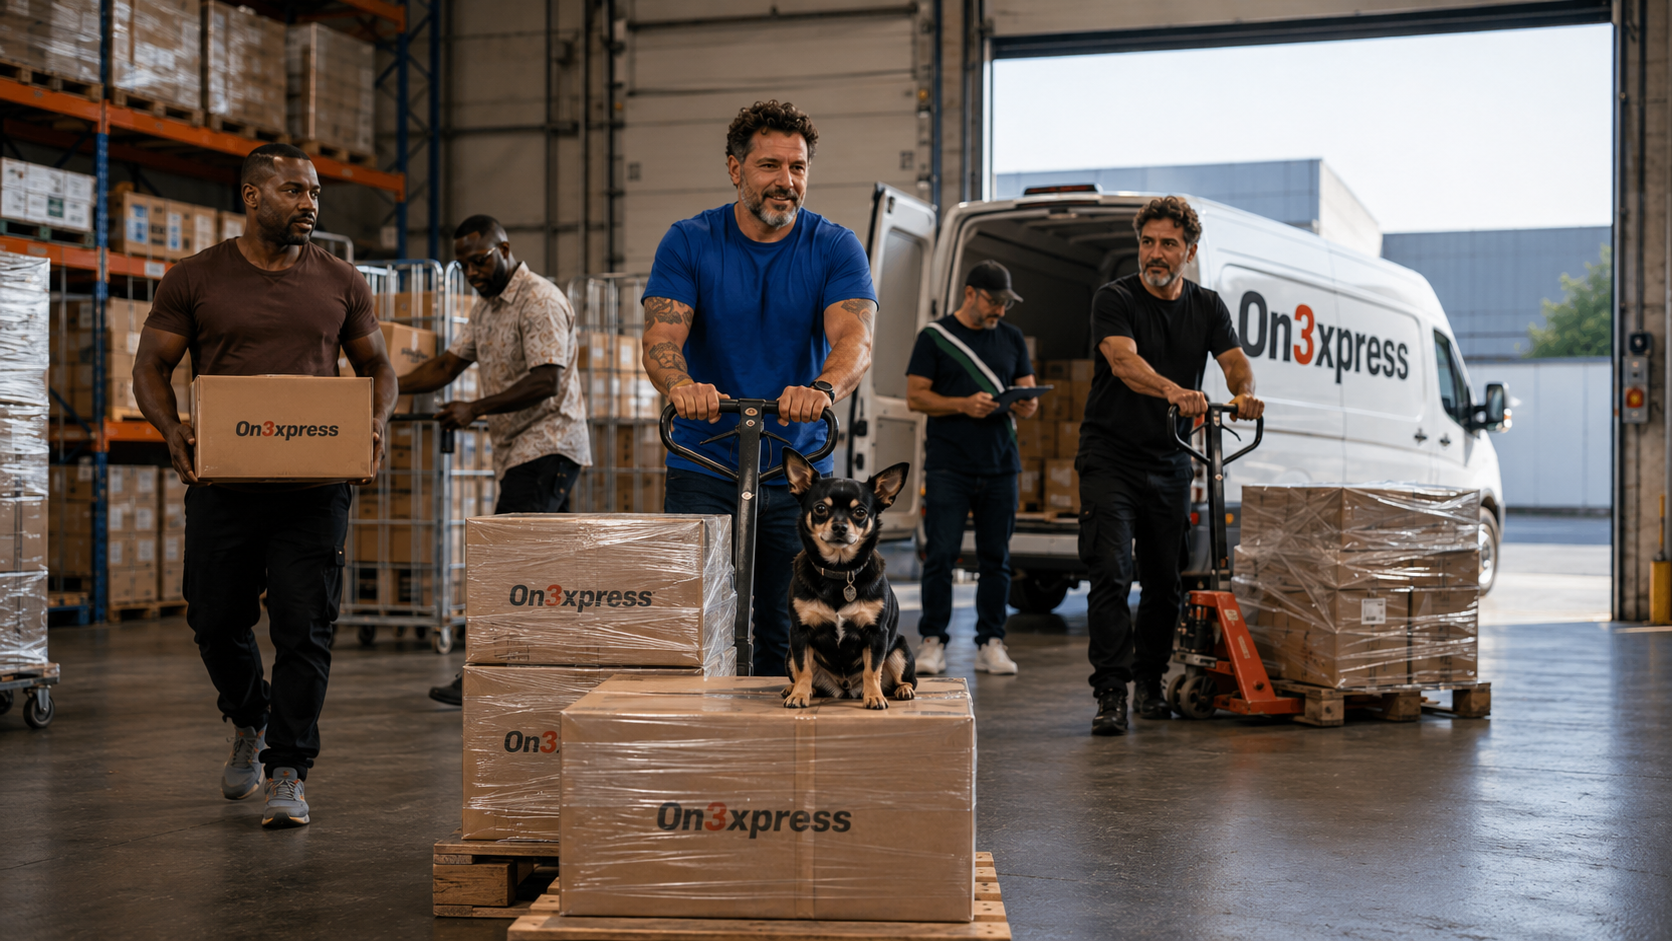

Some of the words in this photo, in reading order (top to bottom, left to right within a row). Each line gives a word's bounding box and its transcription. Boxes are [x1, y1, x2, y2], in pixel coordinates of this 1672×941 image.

[1238, 290, 1408, 384] On3xpress
[235, 420, 339, 441] On3xpress
[509, 584, 653, 613] On3xpress
[504, 730, 560, 754] On3
[656, 802, 852, 839] On3xpress
